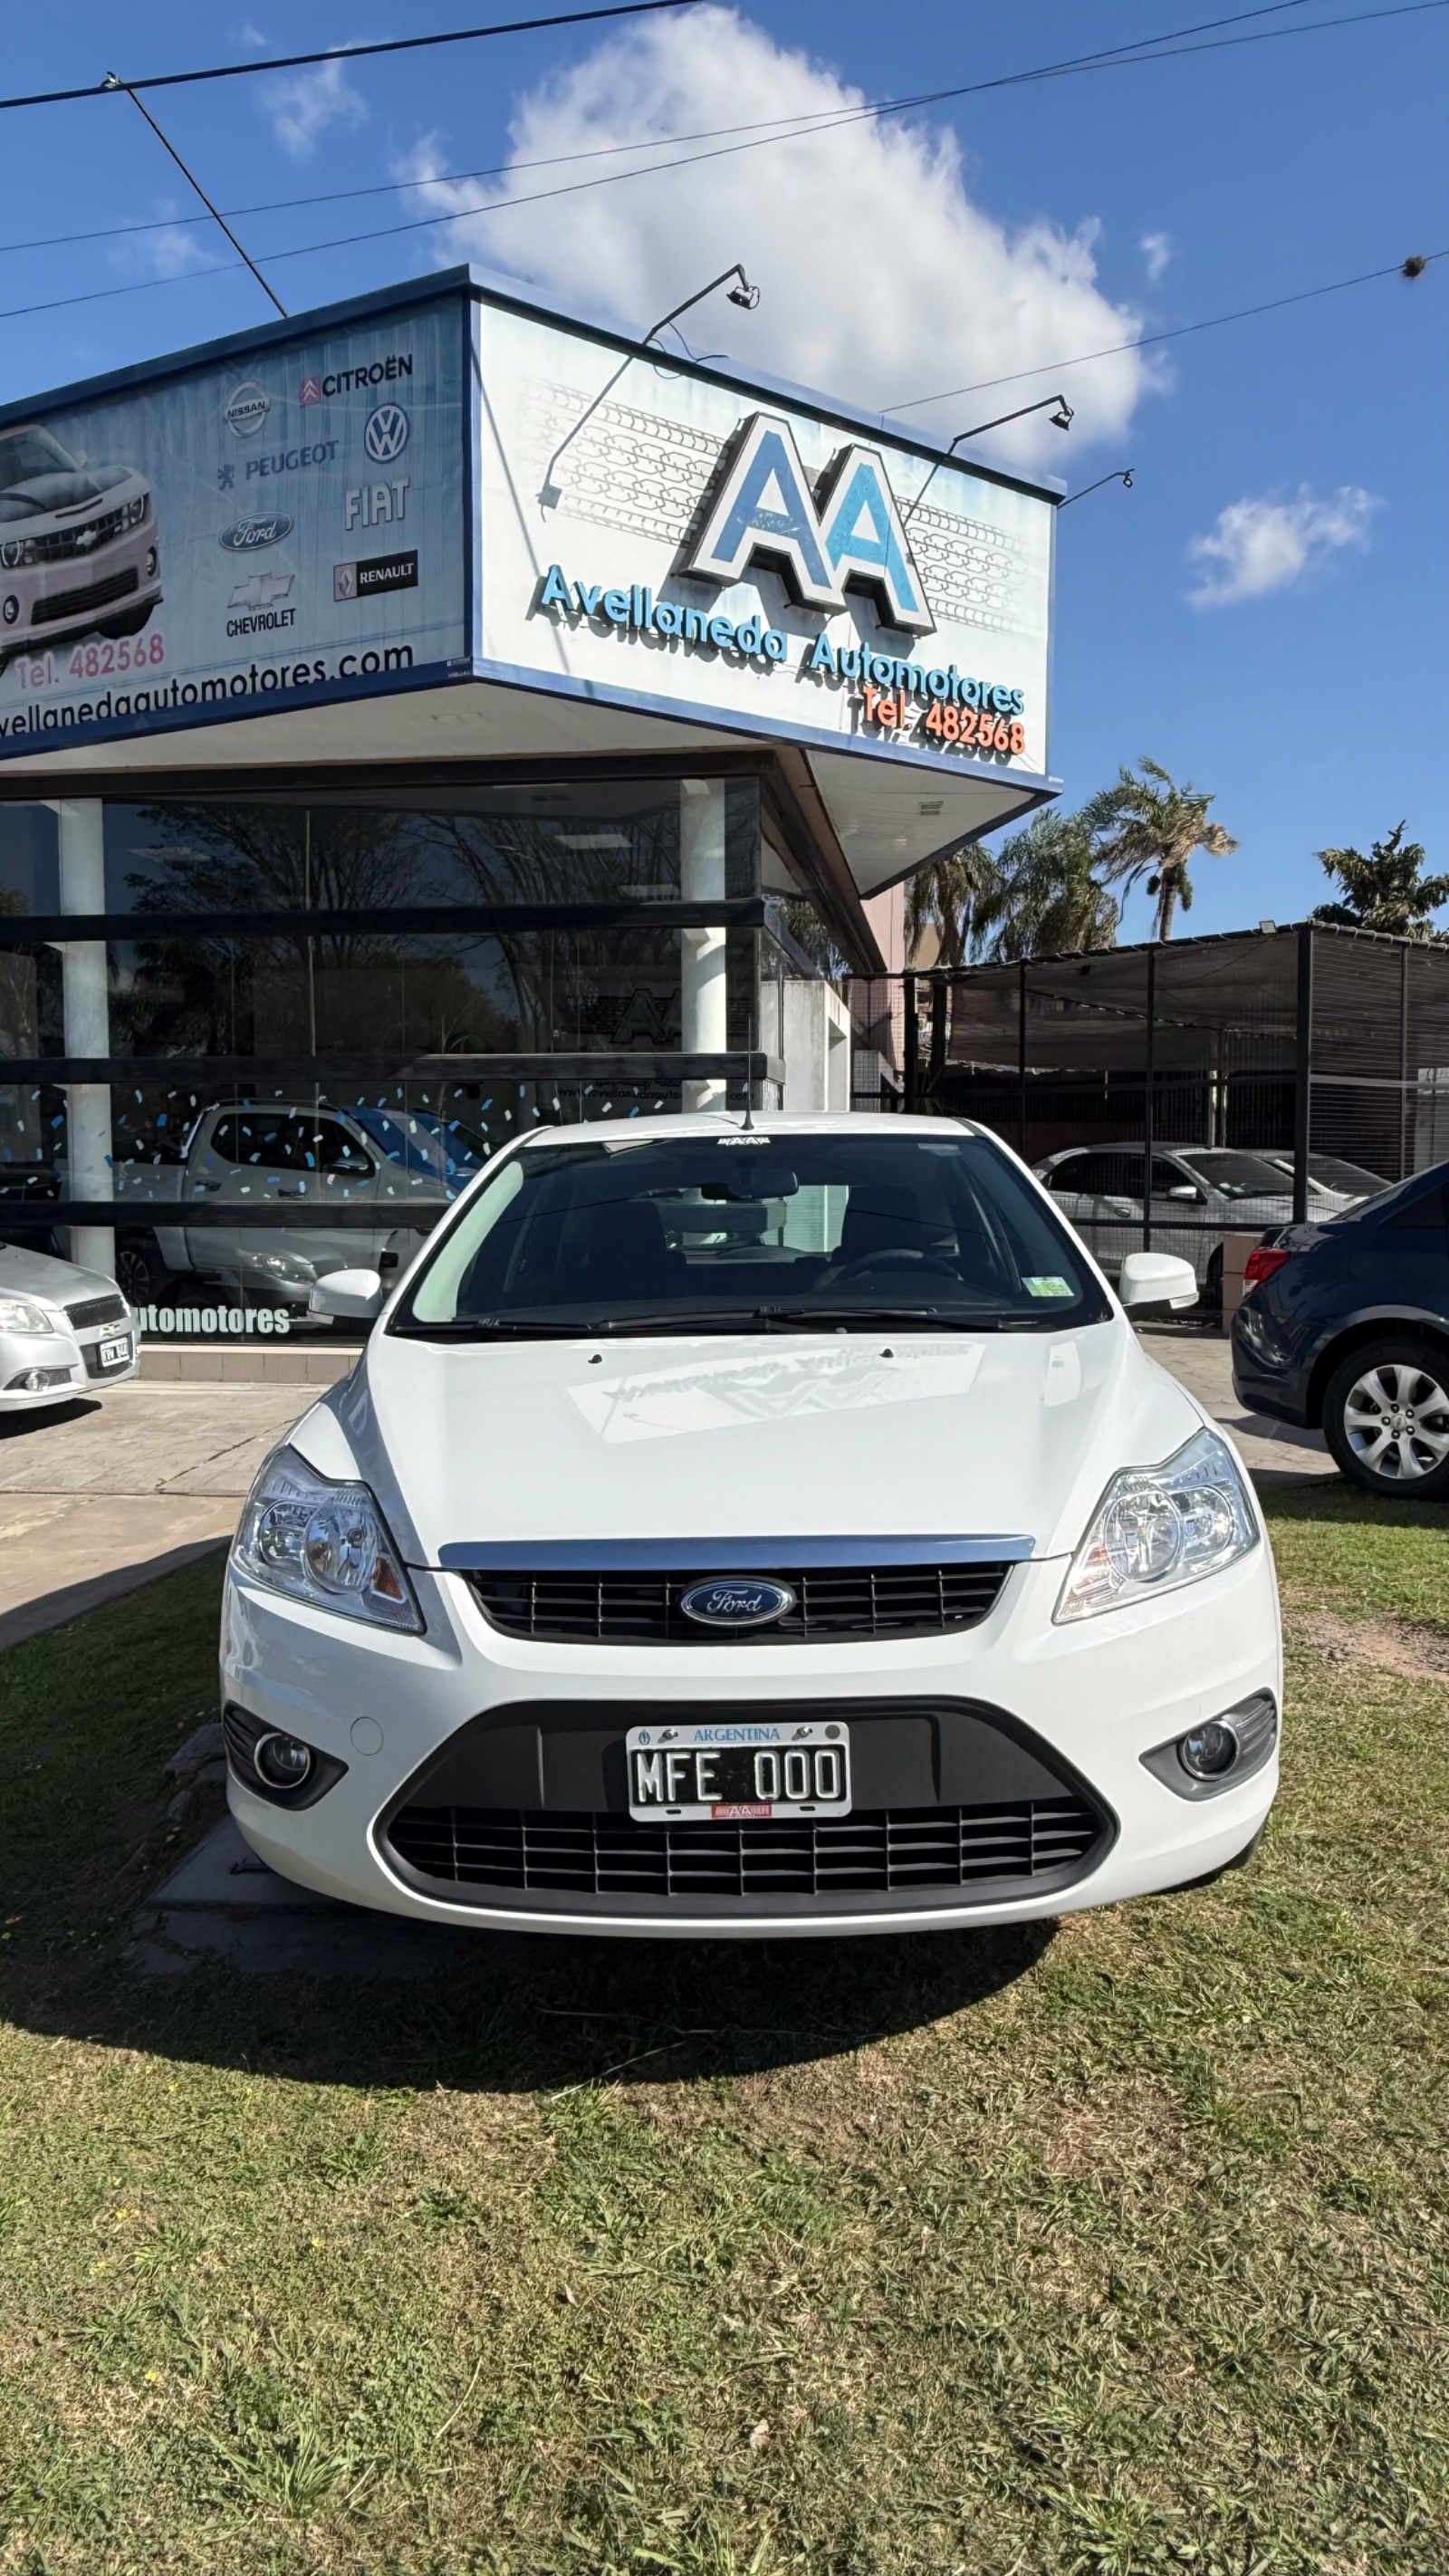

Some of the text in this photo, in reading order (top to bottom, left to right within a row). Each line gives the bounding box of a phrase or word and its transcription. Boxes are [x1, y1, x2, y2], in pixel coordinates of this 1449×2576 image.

[322, 354, 413, 398] CITROËN
[226, 401, 266, 418] NISSAN
[246, 440, 340, 480] PEUGEOT
[345, 477, 410, 531] FIAT
[690, 413, 935, 633] AA
[233, 517, 277, 547] Ford
[360, 562, 415, 584] RENAULT
[226, 608, 296, 638] CHEVROLET
[541, 563, 1025, 716] Avellaneda Automotores
[16, 633, 164, 689] Tel. 482568
[0, 645, 413, 738] vellanedaautomotores.com
[926, 699, 1025, 755] 482568
[705, 1590, 763, 1613] Ford
[694, 1727, 781, 1743] ARGENTINA
[636, 1748, 842, 1803] MFE 000
